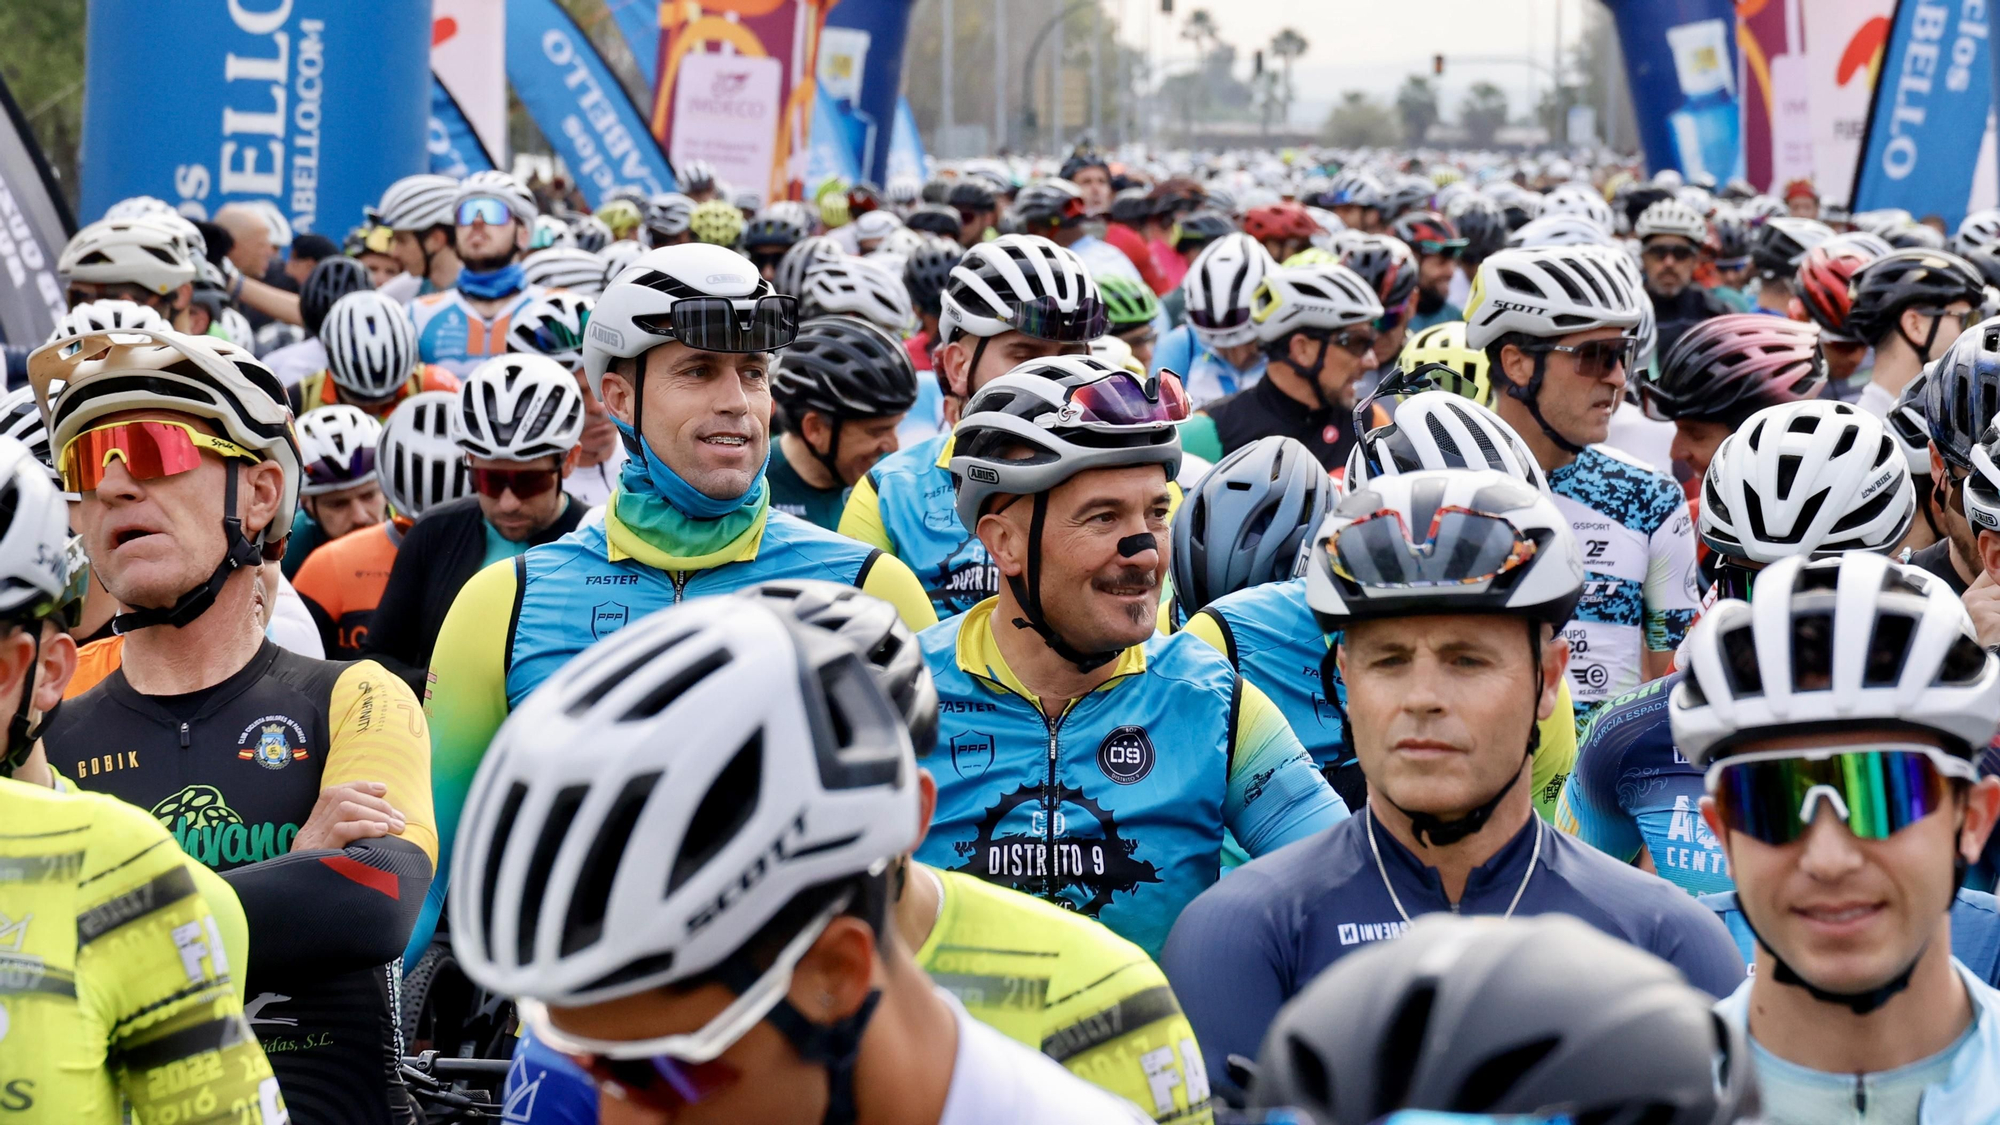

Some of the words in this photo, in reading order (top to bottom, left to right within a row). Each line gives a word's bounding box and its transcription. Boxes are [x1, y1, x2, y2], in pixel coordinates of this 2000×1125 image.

[219, 0, 296, 199] ELLO
[1881, 0, 1950, 182] BELLO
[1492, 299, 1549, 315] SCOTT
[592, 325, 619, 348] ABUS
[970, 471, 995, 482] ABUS
[585, 575, 639, 586] FASTER
[597, 613, 624, 621] PPP
[937, 700, 998, 713] FASTER
[1592, 716, 1624, 748] GARCIA
[1626, 700, 1669, 721] ESPADA
[956, 743, 989, 754] PPP
[77, 750, 140, 779] GOBIK
[684, 804, 808, 932] SCOTT
[988, 843, 1084, 877] DISTRITO
[1091, 845, 1106, 876] 9
